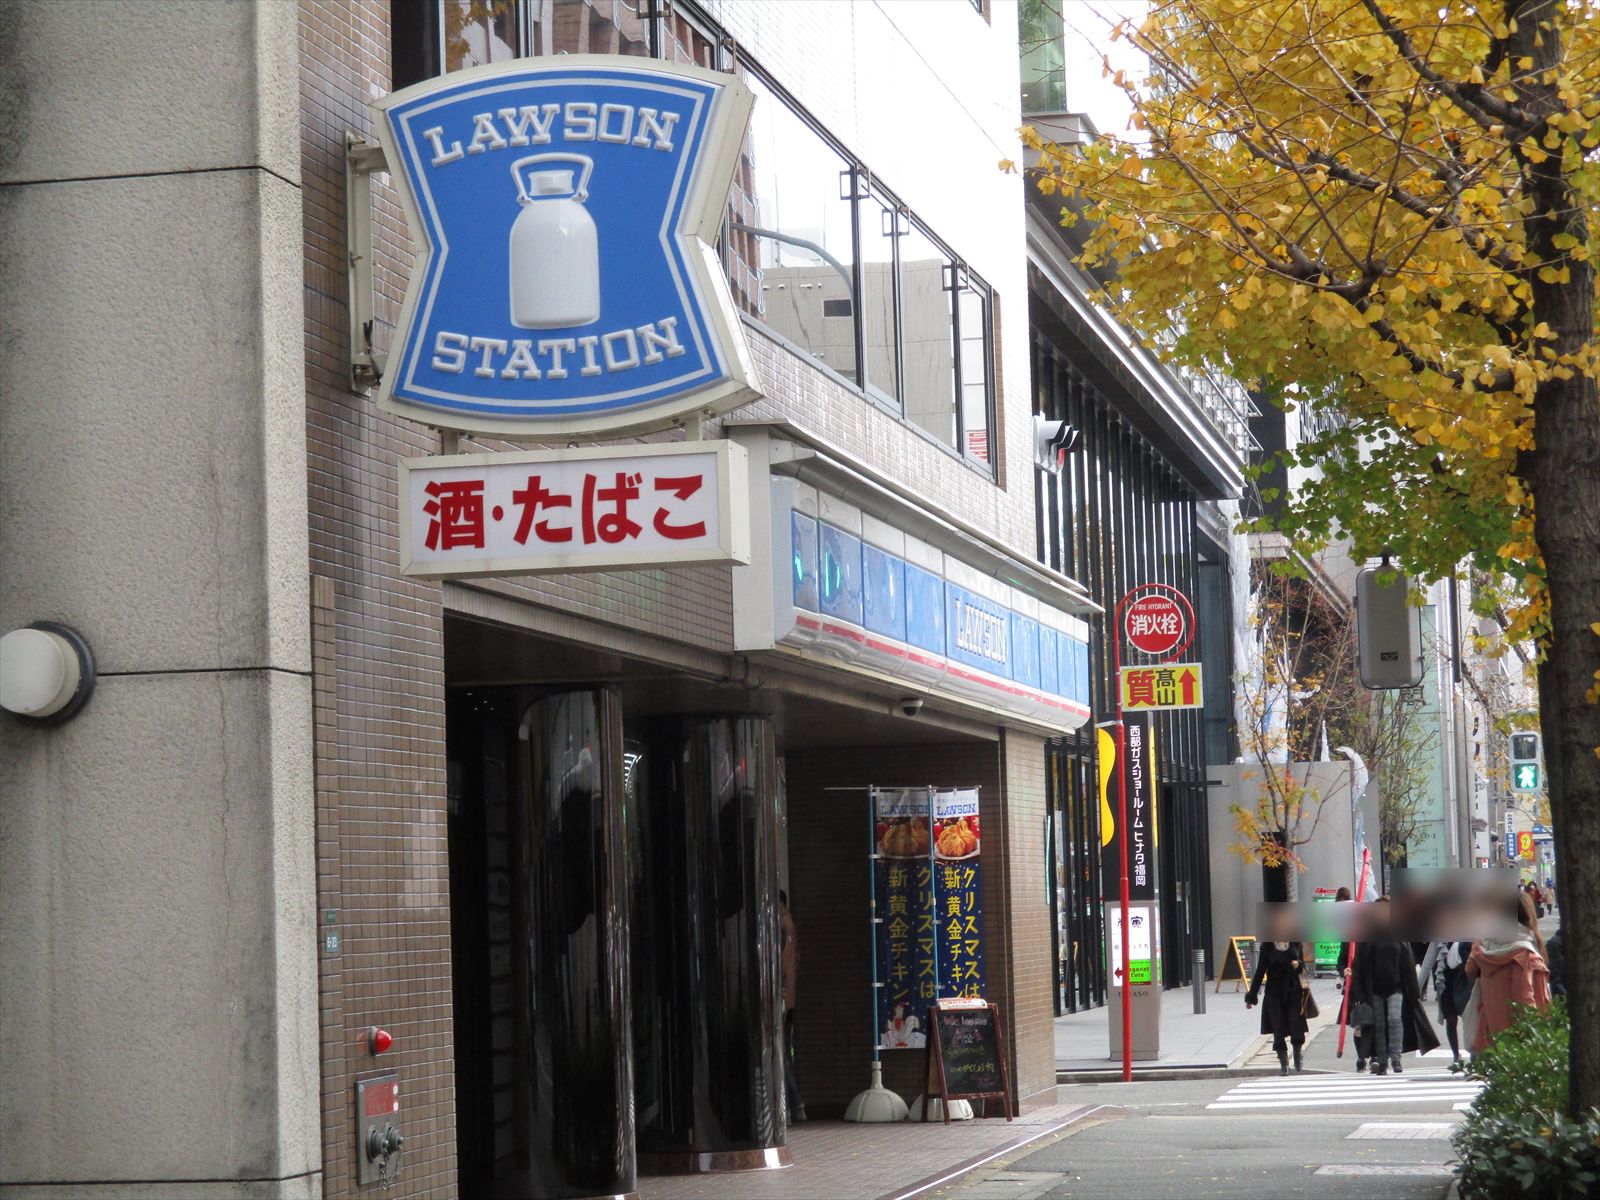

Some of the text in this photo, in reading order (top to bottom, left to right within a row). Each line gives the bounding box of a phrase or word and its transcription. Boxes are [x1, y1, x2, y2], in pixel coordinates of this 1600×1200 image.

[422, 101, 681, 167] LAWSON
[431, 316, 685, 379] STATION
[422, 472, 707, 551] 酒・たばこ
[955, 599, 1006, 665] LAWSON
[1131, 613, 1178, 635] 消火栓
[1148, 602, 1173, 610] HYDRANT
[1127, 670, 1156, 707] 質
[937, 803, 976, 816] LAWSON
[1129, 725, 1146, 887] 西部ガスショールーム ヒナタ福岡
